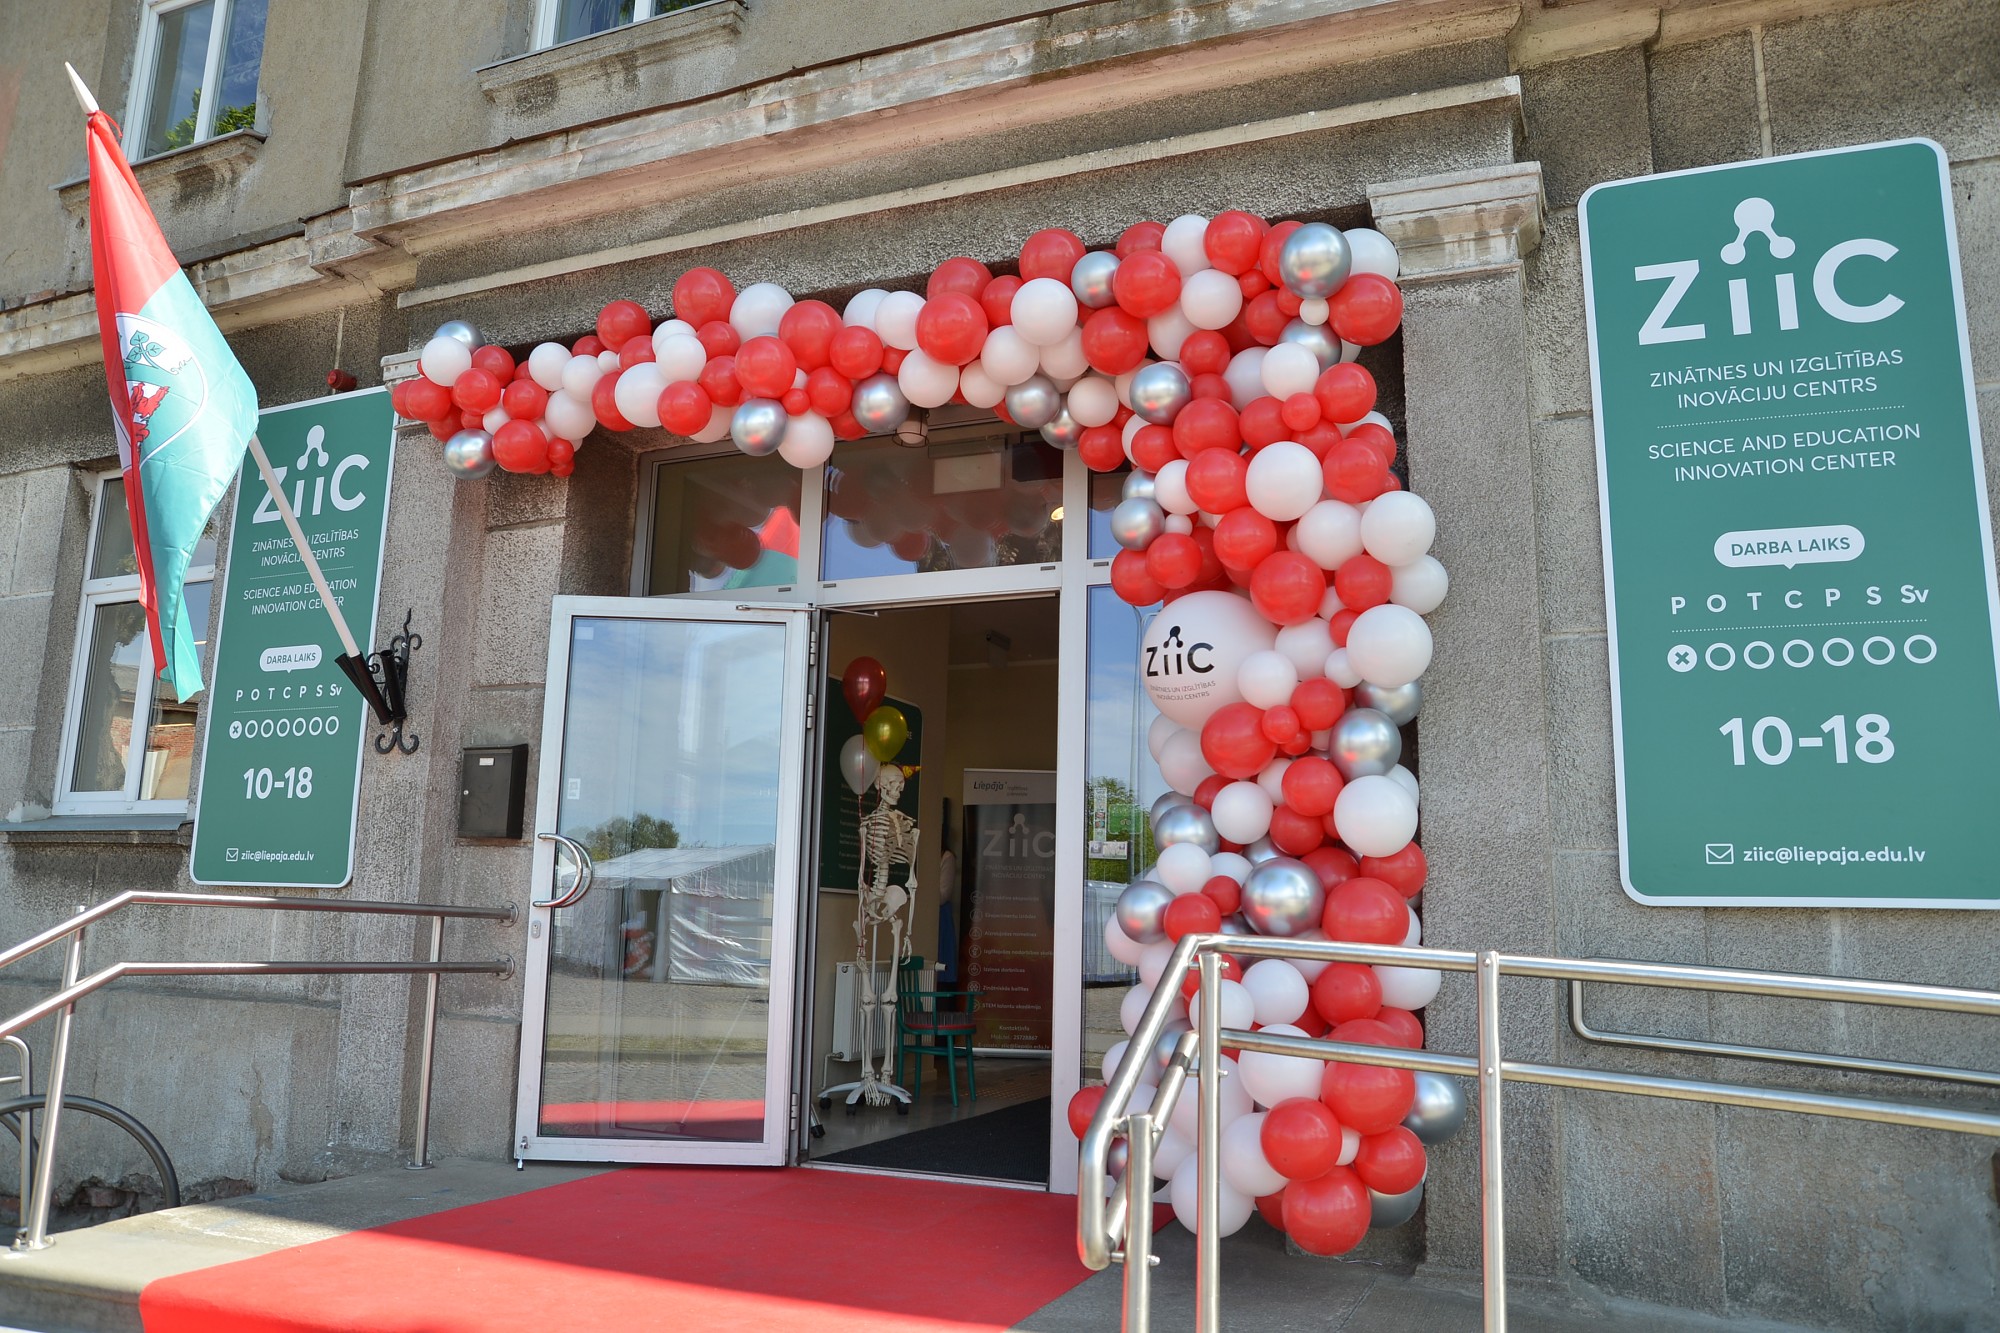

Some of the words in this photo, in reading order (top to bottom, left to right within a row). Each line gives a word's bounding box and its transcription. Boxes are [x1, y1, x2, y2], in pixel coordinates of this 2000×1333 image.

[1649, 363, 1748, 389] ZINĀTNES
[1753, 359, 1784, 378] UN
[1790, 348, 1904, 375] IZGLĪTĪBAS
[1677, 383, 1787, 409] INOVĀCIJU
[1793, 376, 1878, 399] CENTRS
[1648, 437, 1736, 460] SCIENCE
[1741, 433, 1787, 452] AND
[1794, 422, 1921, 448] EDUCATION
[1674, 456, 1804, 482] INNOVATION
[1810, 450, 1897, 472] CENTER
[252, 537, 294, 552] ZINĀTNES
[311, 528, 359, 545] IZGLĪTĪBAS
[1730, 539, 1793, 557] DARBA
[1798, 536, 1851, 553] LAIKS
[311, 546, 346, 560] CENTRS
[243, 586, 281, 600] SCIENCE
[282, 584, 303, 596] AND
[1671, 596, 1686, 615] P
[1706, 593, 1727, 613] O
[1746, 591, 1763, 611] T
[1784, 589, 1804, 609] C
[1825, 588, 1841, 607] P
[1865, 586, 1882, 605] S
[1900, 584, 1930, 604] Sv
[251, 599, 307, 615] INNOVATION
[308, 596, 345, 610] CENER
[266, 652, 293, 665] DARBA
[294, 651, 317, 663] LAIKS
[235, 689, 243, 701] P
[251, 688, 260, 700] O
[268, 687, 276, 700] T
[283, 686, 291, 699] C
[299, 685, 307, 698] P
[316, 684, 323, 697] S
[329, 683, 343, 697] Sv
[1718, 713, 1896, 766] 10-18
[243, 766, 314, 800] 10-18
[241, 850, 315, 863] ziic@liepaja.edu.lv
[1742, 846, 1926, 866] ziic@liepaja.edu.lv
